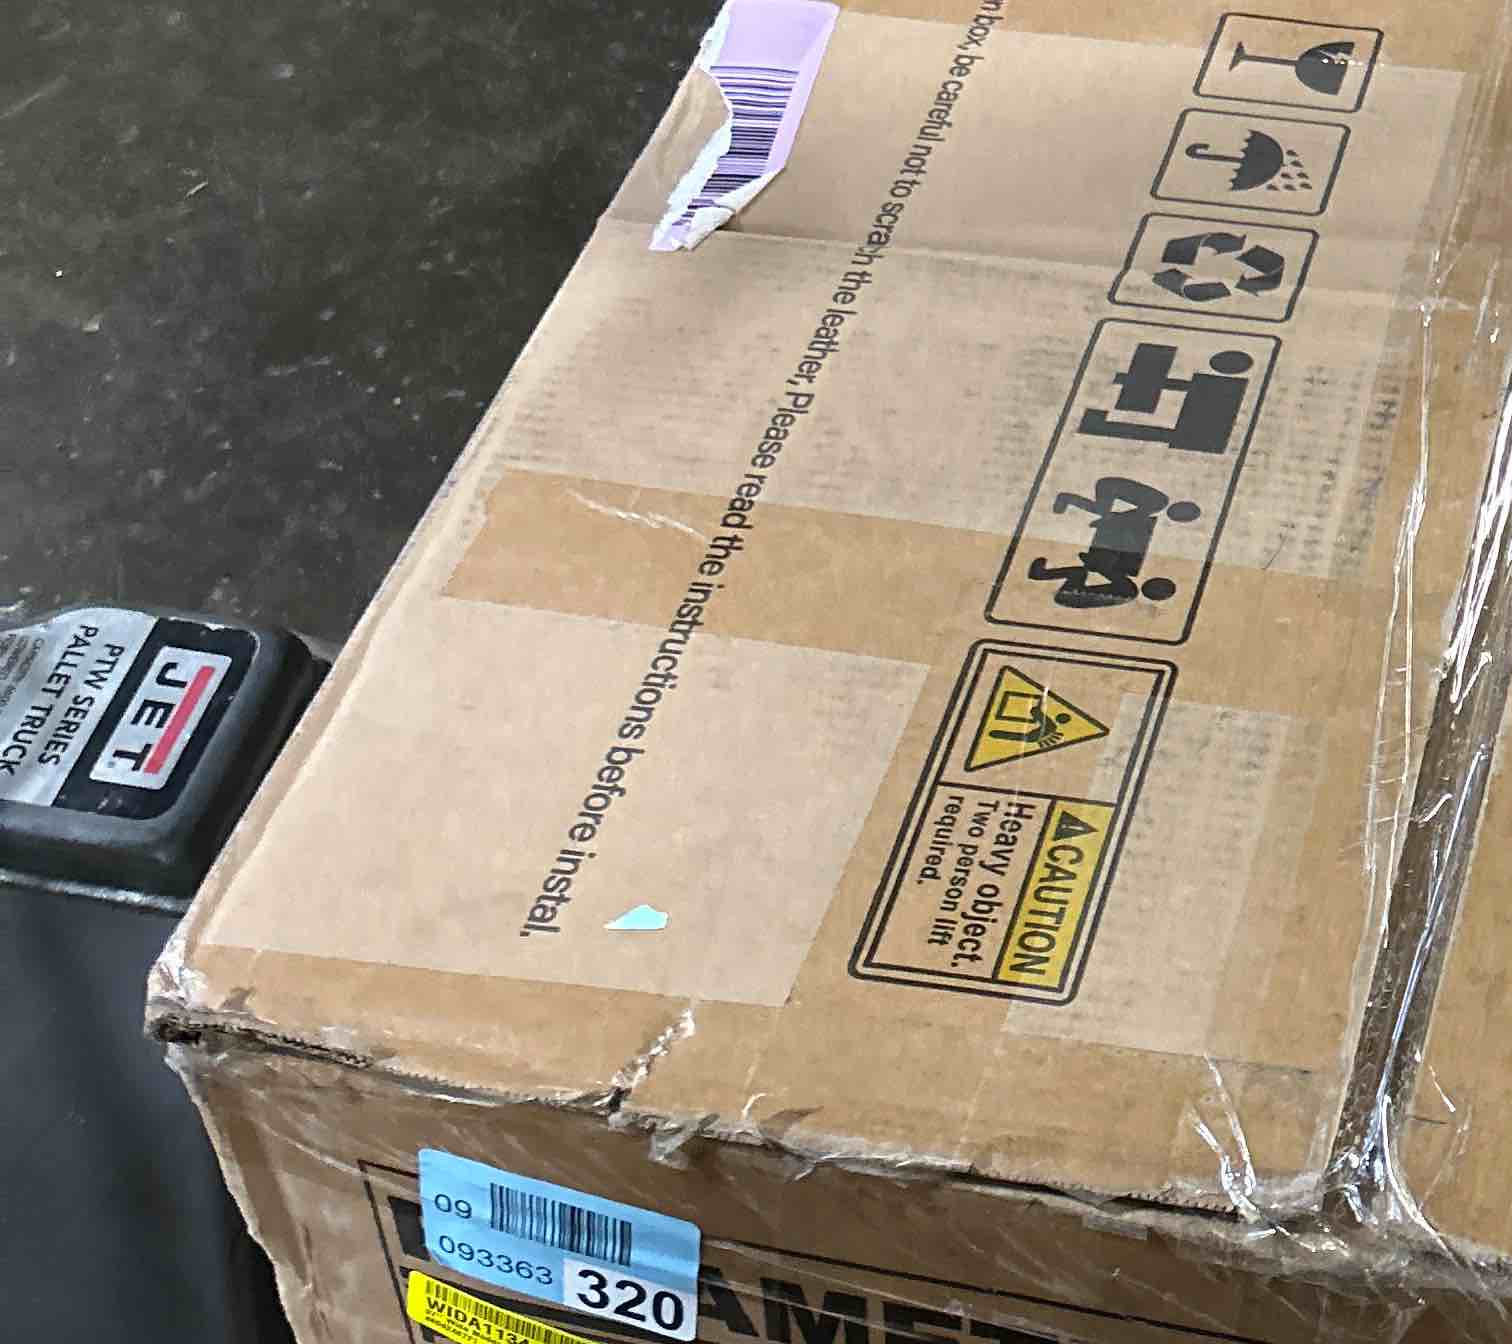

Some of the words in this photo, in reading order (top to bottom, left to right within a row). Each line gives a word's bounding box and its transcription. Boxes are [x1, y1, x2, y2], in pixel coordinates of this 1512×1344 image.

[956, 12, 1005, 51] box,
[948, 52, 984, 78] be
[916, 78, 964, 143] careful
[890, 177, 922, 199] to
[901, 143, 933, 176] not
[849, 199, 908, 267] scrach
[830, 269, 873, 305] the
[785, 307, 857, 386] leather,
[749, 389, 815, 469] Please
[719, 472, 767, 530] read
[697, 533, 744, 577] the
[42, 625, 99, 699] PALLET
[84, 643, 125, 690] PTW
[617, 580, 724, 739] instructions
[0, 703, 54, 776] TRUCK
[38, 695, 95, 766] SERIES
[113, 662, 188, 771] JET
[567, 745, 645, 843] before
[967, 800, 999, 838] Two
[917, 795, 964, 885] required.
[979, 801, 1038, 876] Heavy
[940, 843, 978, 912] person
[1010, 844, 1084, 976] CAUTION
[928, 917, 956, 946] lift
[950, 883, 1003, 968] object.
[434, 1194, 472, 1219] 09
[439, 1235, 553, 1285] 093363
[576, 1269, 684, 1332] 320
